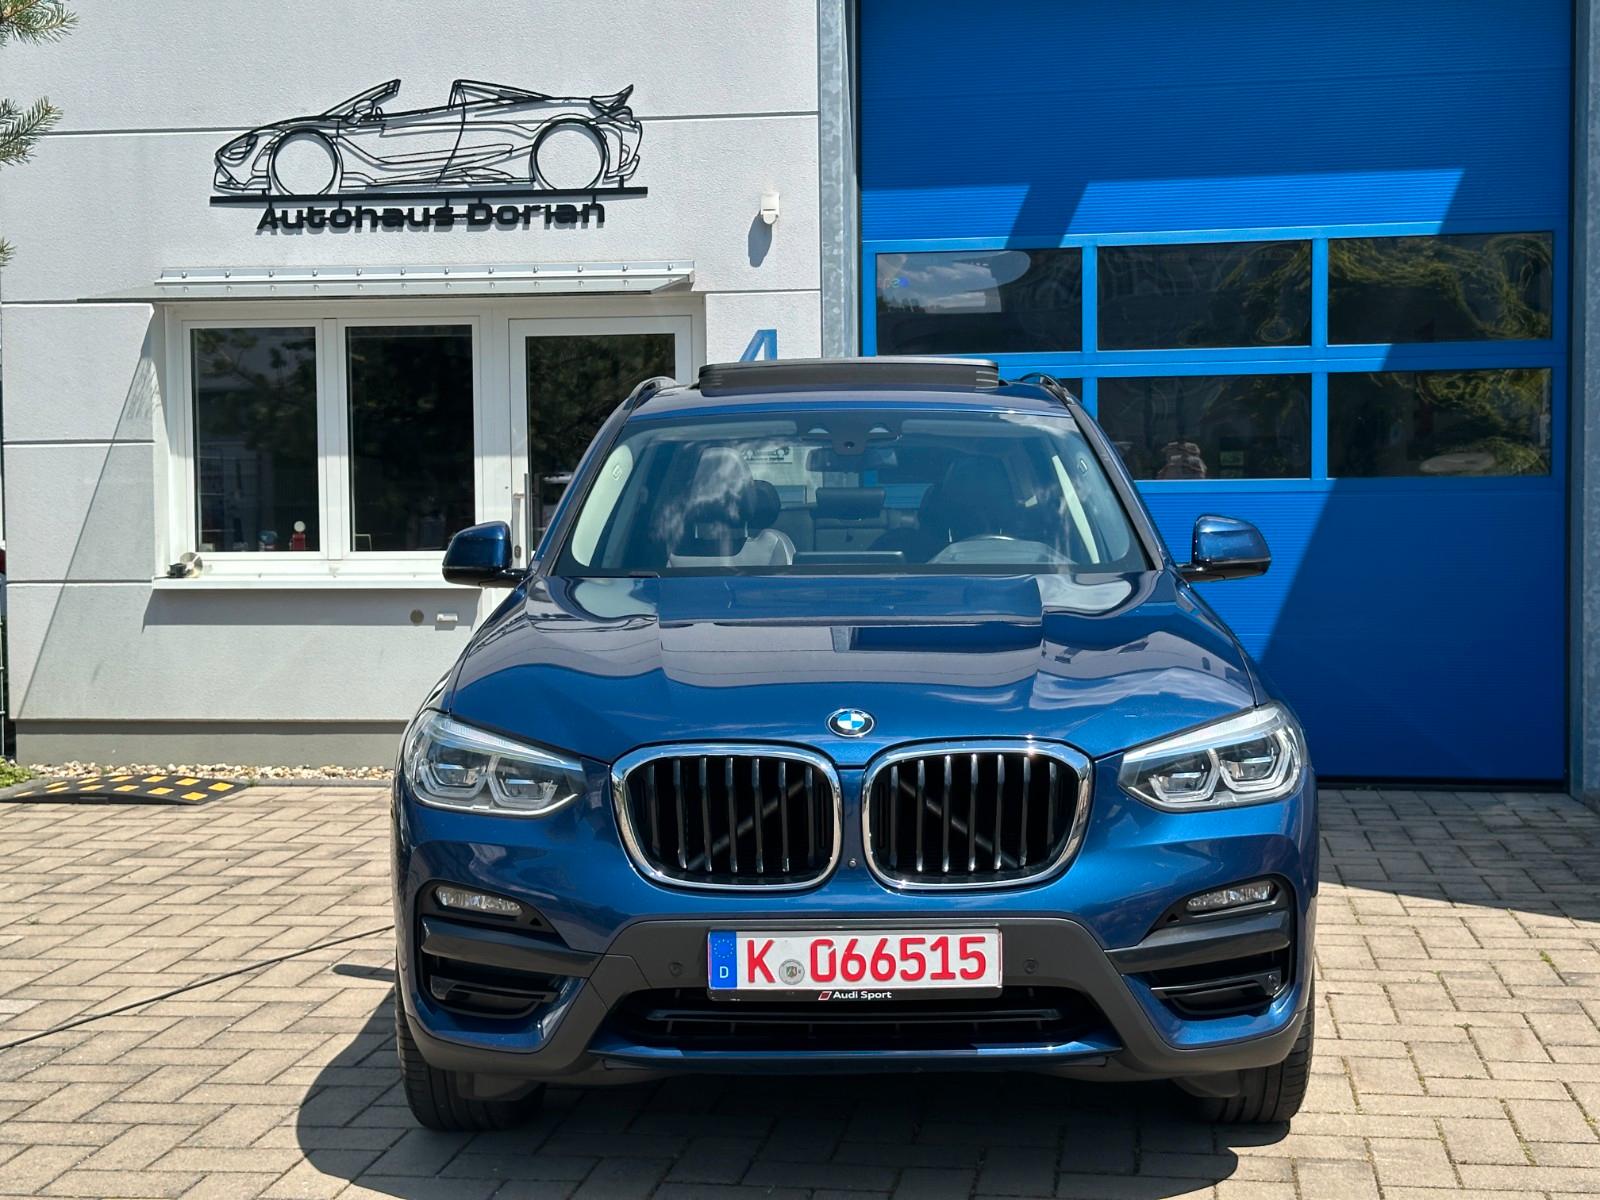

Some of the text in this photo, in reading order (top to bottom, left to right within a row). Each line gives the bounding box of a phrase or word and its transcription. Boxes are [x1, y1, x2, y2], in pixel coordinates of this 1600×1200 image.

[257, 202, 606, 230] Autohaus Dorian
[747, 939, 776, 984] K
[810, 936, 986, 983] 066515
[719, 966, 729, 978] D
[833, 991, 892, 1001] Audi Sport
